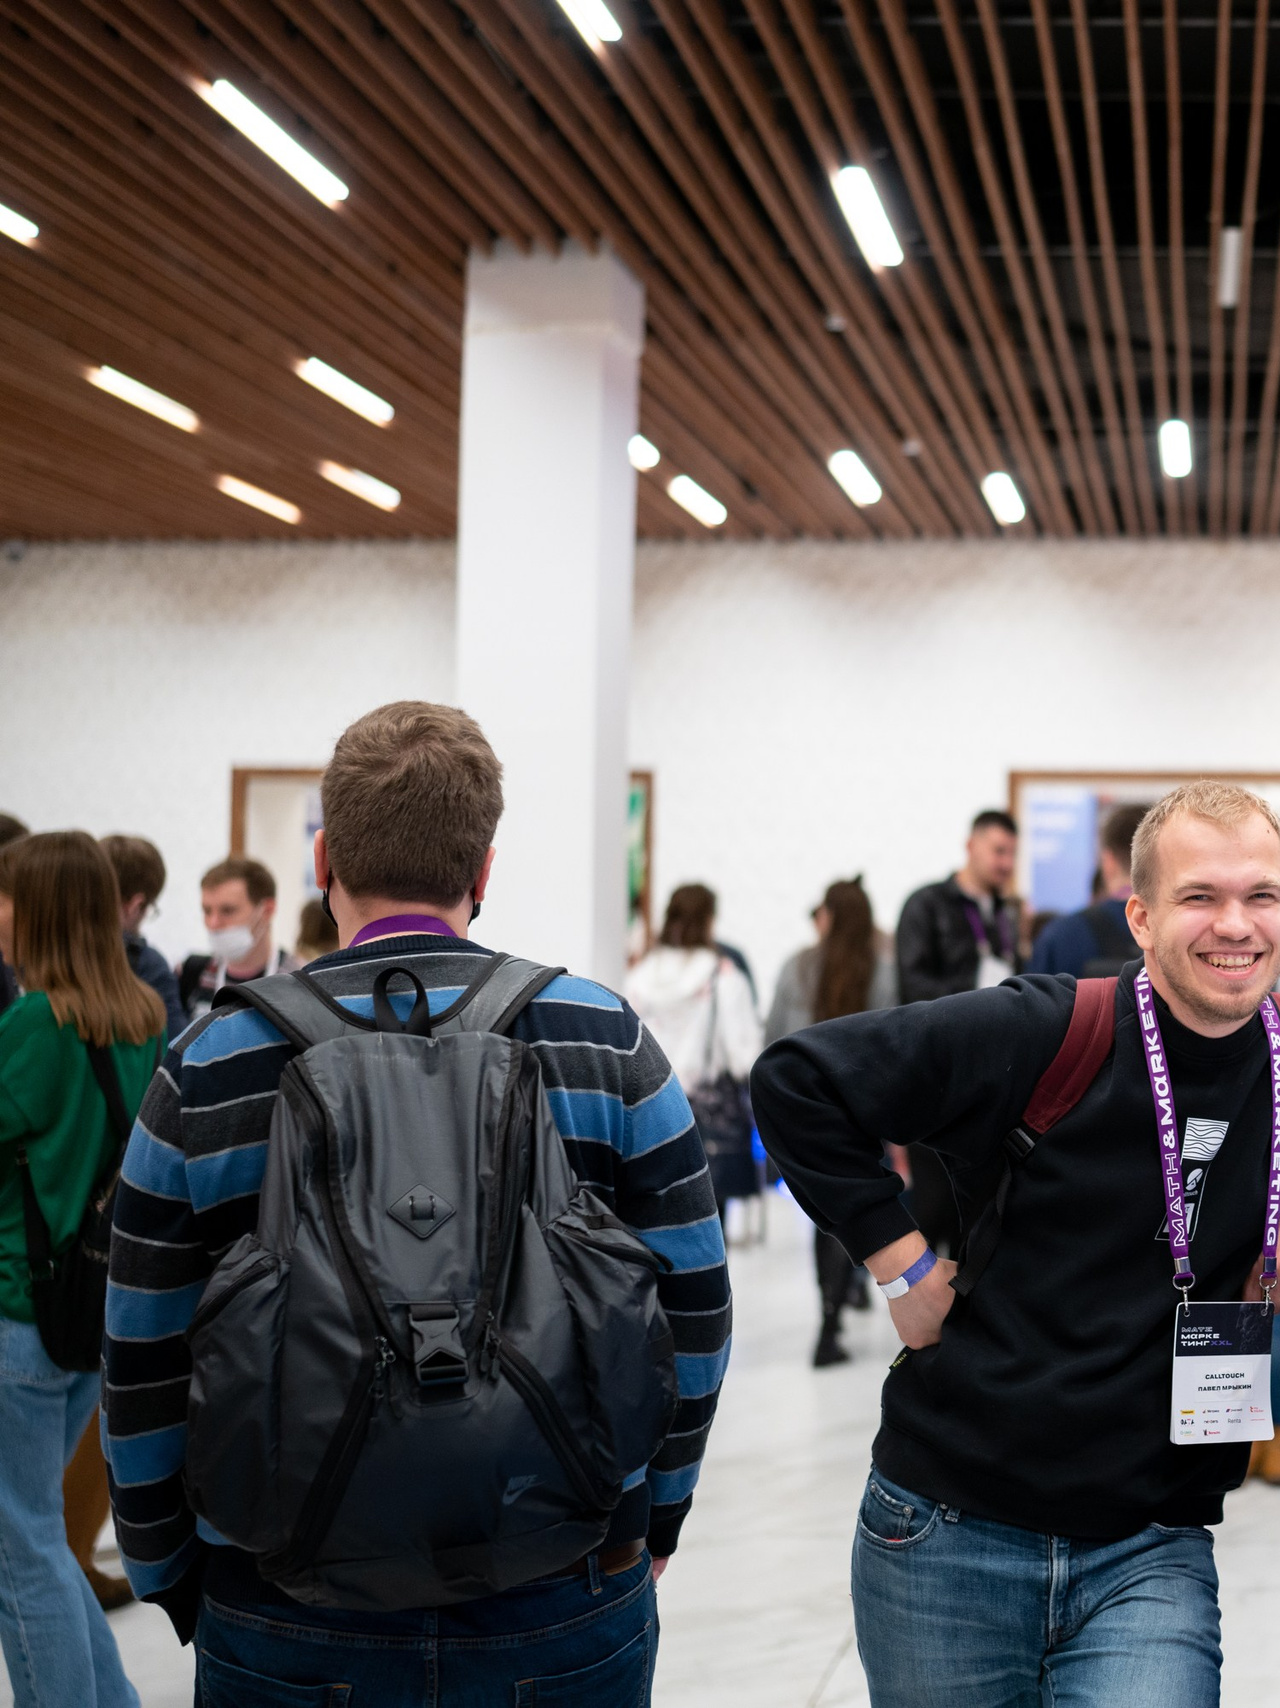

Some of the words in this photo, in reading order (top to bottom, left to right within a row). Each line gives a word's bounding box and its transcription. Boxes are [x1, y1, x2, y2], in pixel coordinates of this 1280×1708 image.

[1162, 1129, 1175, 1149] &
[1164, 1152, 1186, 1247] MATH
[1205, 1372, 1245, 1380] CALLTOUCH
